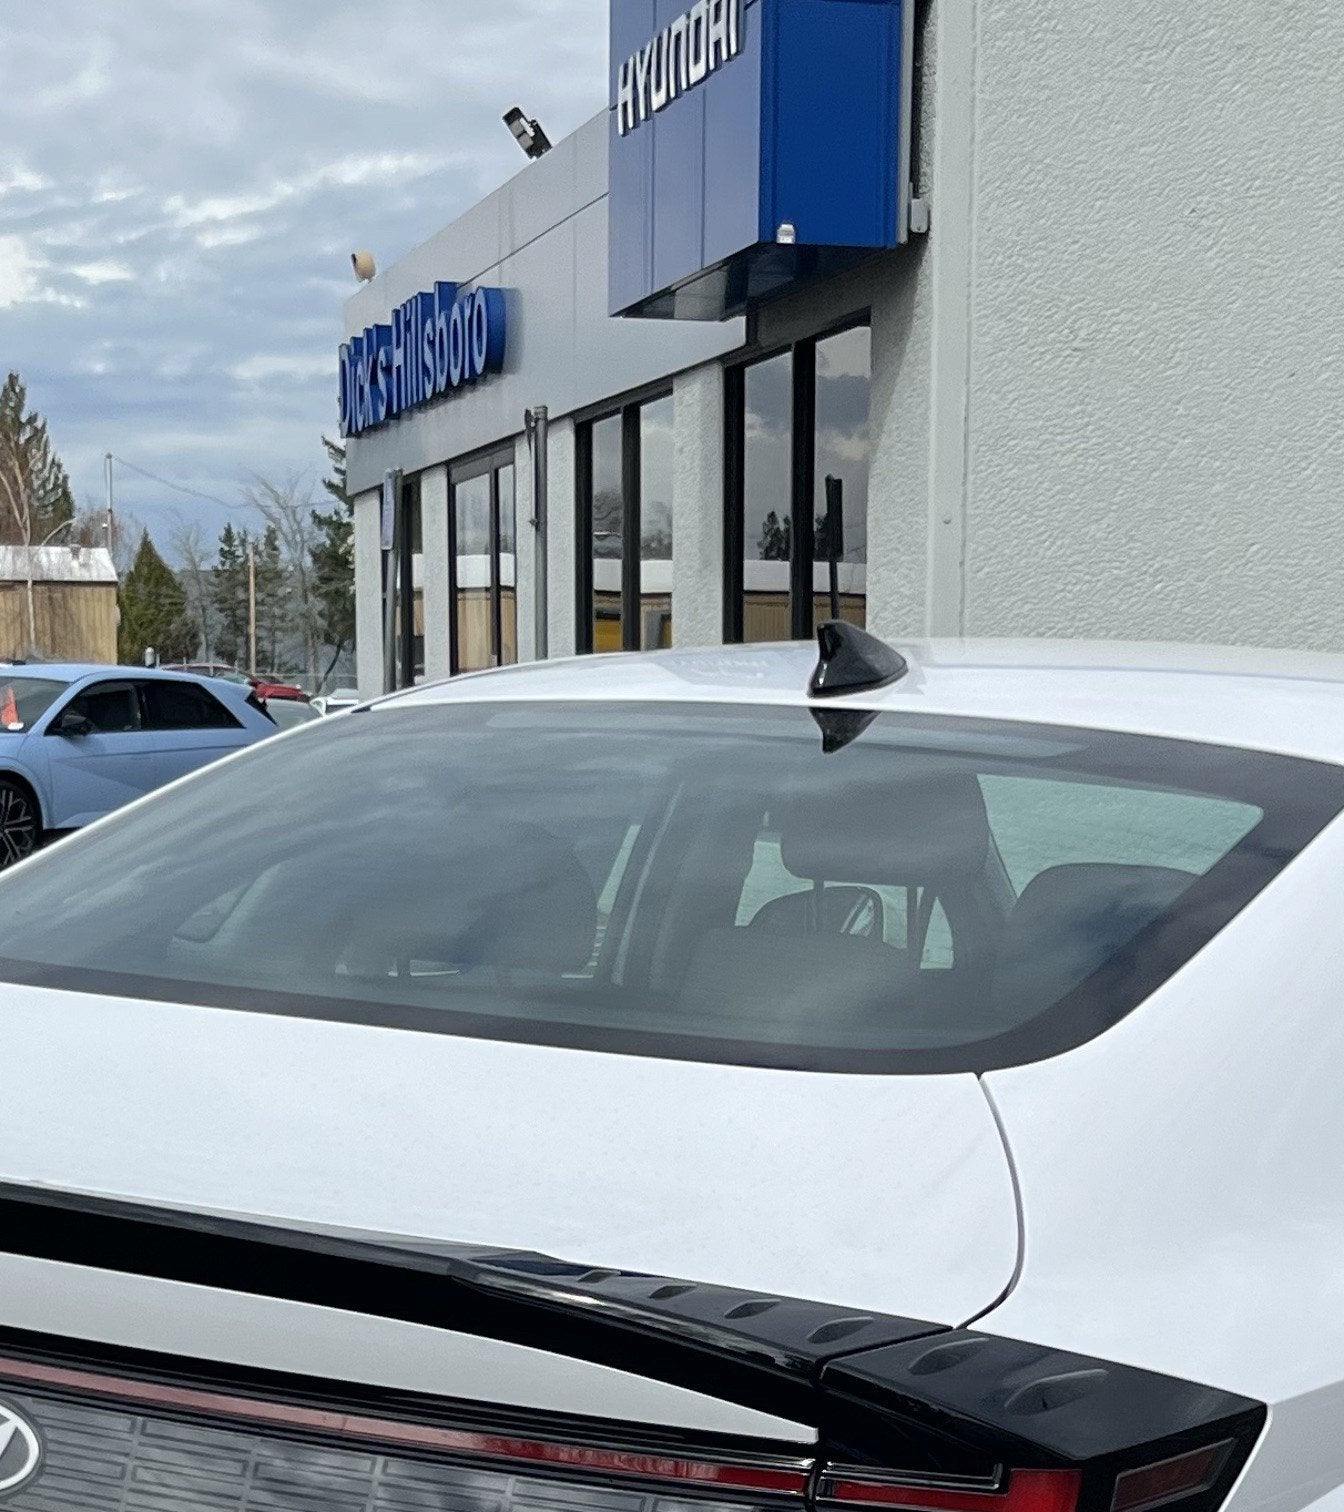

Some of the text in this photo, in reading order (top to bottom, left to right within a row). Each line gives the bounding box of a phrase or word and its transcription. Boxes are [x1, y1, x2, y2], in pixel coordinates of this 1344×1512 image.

[618, 0, 738, 135] HYUNDAI
[339, 280, 488, 438] Dick's Hillsboro
